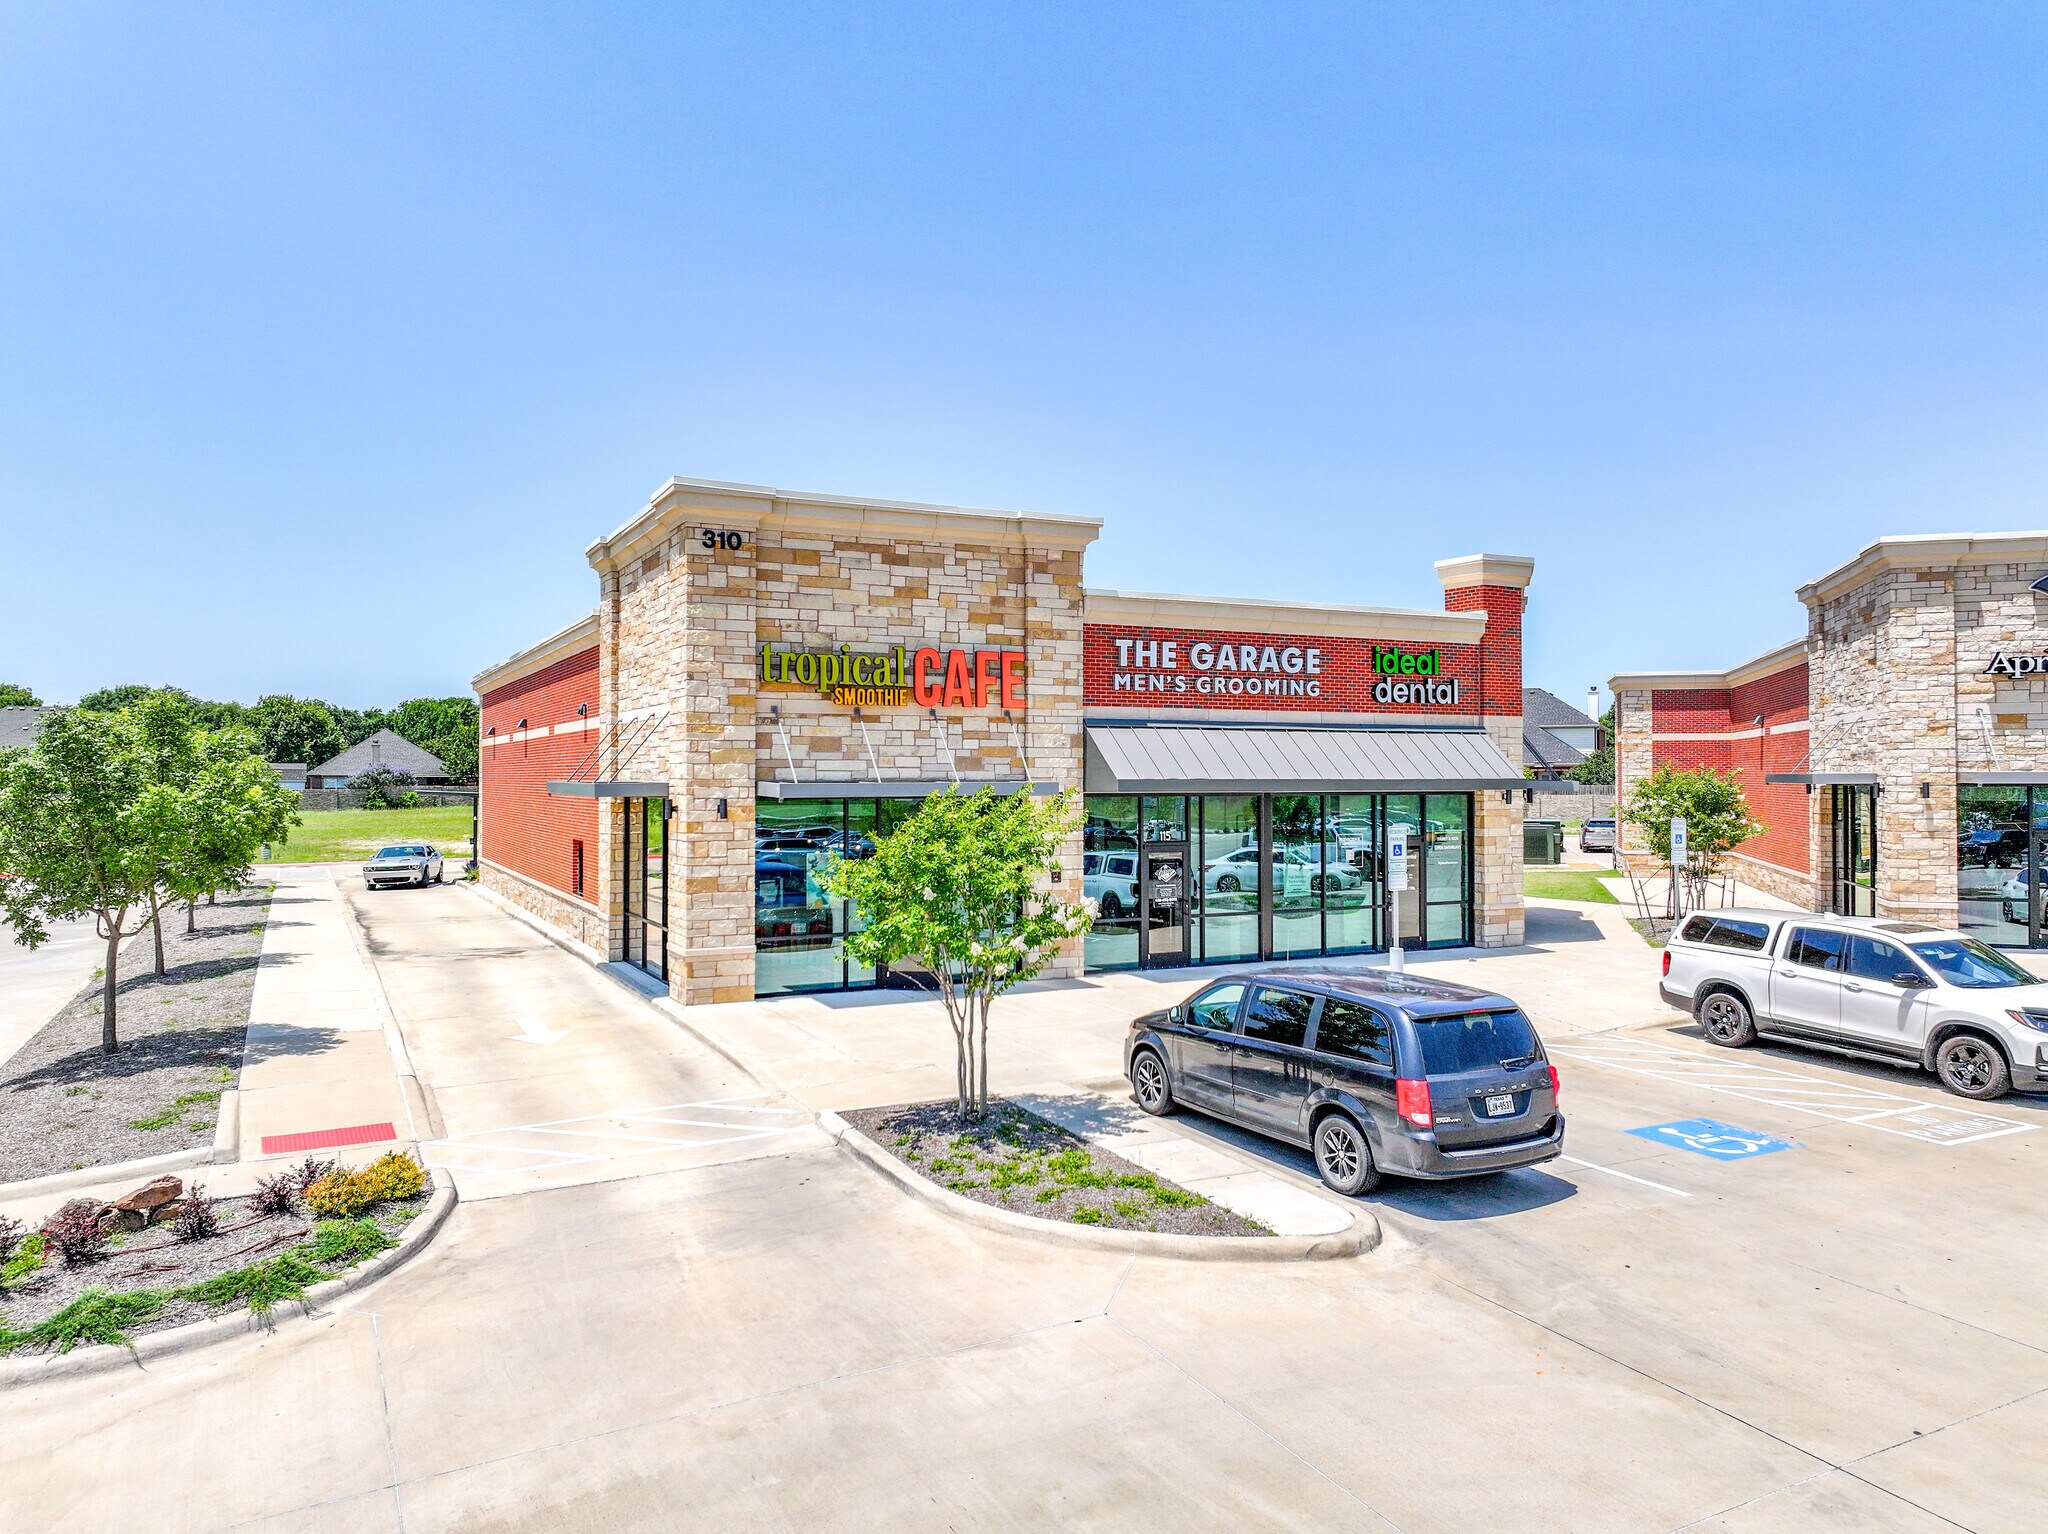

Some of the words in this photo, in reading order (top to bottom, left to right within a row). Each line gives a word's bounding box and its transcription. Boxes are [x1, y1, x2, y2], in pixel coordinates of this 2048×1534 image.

[702, 529, 743, 551] 310
[1114, 639, 1178, 669] THE
[1189, 642, 1321, 674] GARAGE
[1373, 645, 1441, 675] ideal
[759, 642, 907, 693] tropical
[913, 647, 1027, 709] CAFE
[1114, 673, 1187, 692] MEN'S
[1196, 675, 1321, 697] GROOMING
[833, 686, 909, 707] SMOOTHIE
[1373, 677, 1459, 705] dental
[1160, 830, 1171, 841] 115
[1474, 1083, 1527, 1094] DODGE
